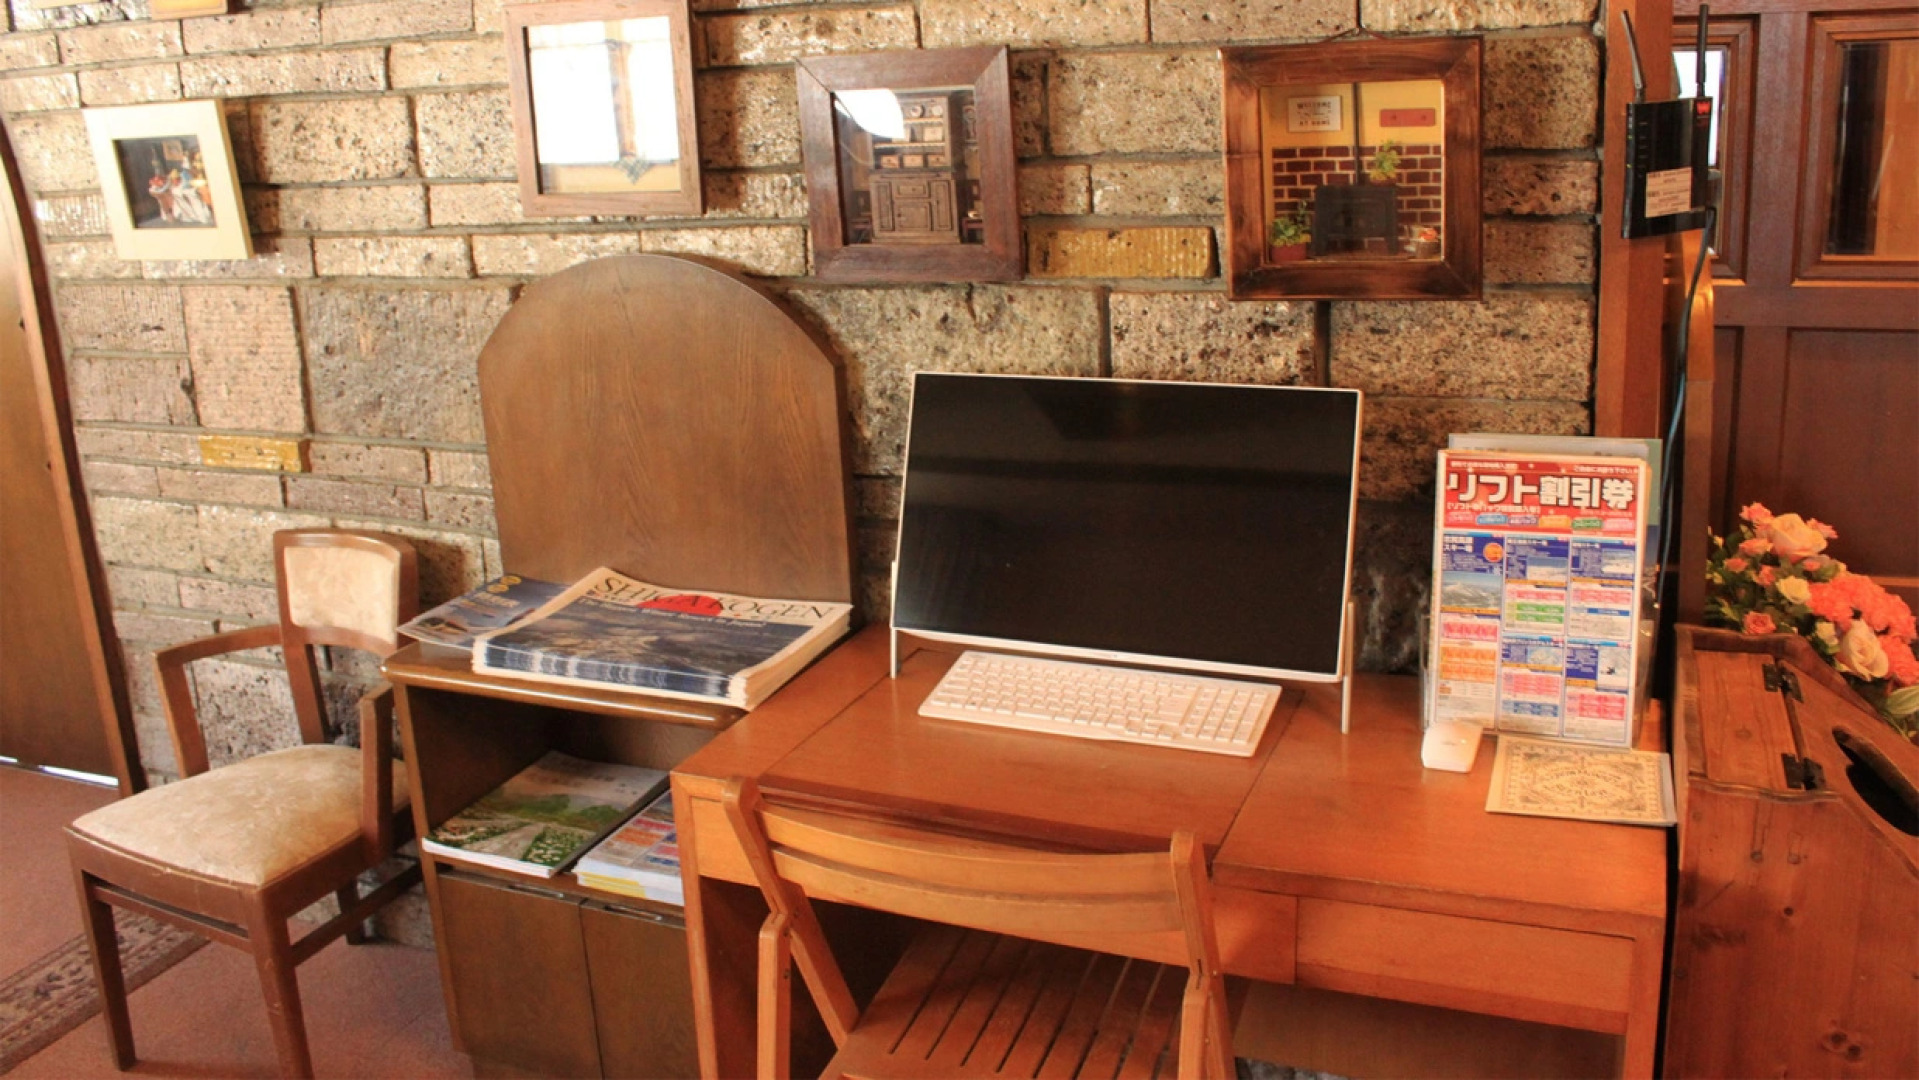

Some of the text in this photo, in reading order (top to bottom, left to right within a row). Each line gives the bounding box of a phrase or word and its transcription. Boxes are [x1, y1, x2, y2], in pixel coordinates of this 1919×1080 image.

[1447, 472, 1635, 511] リフト割引券
